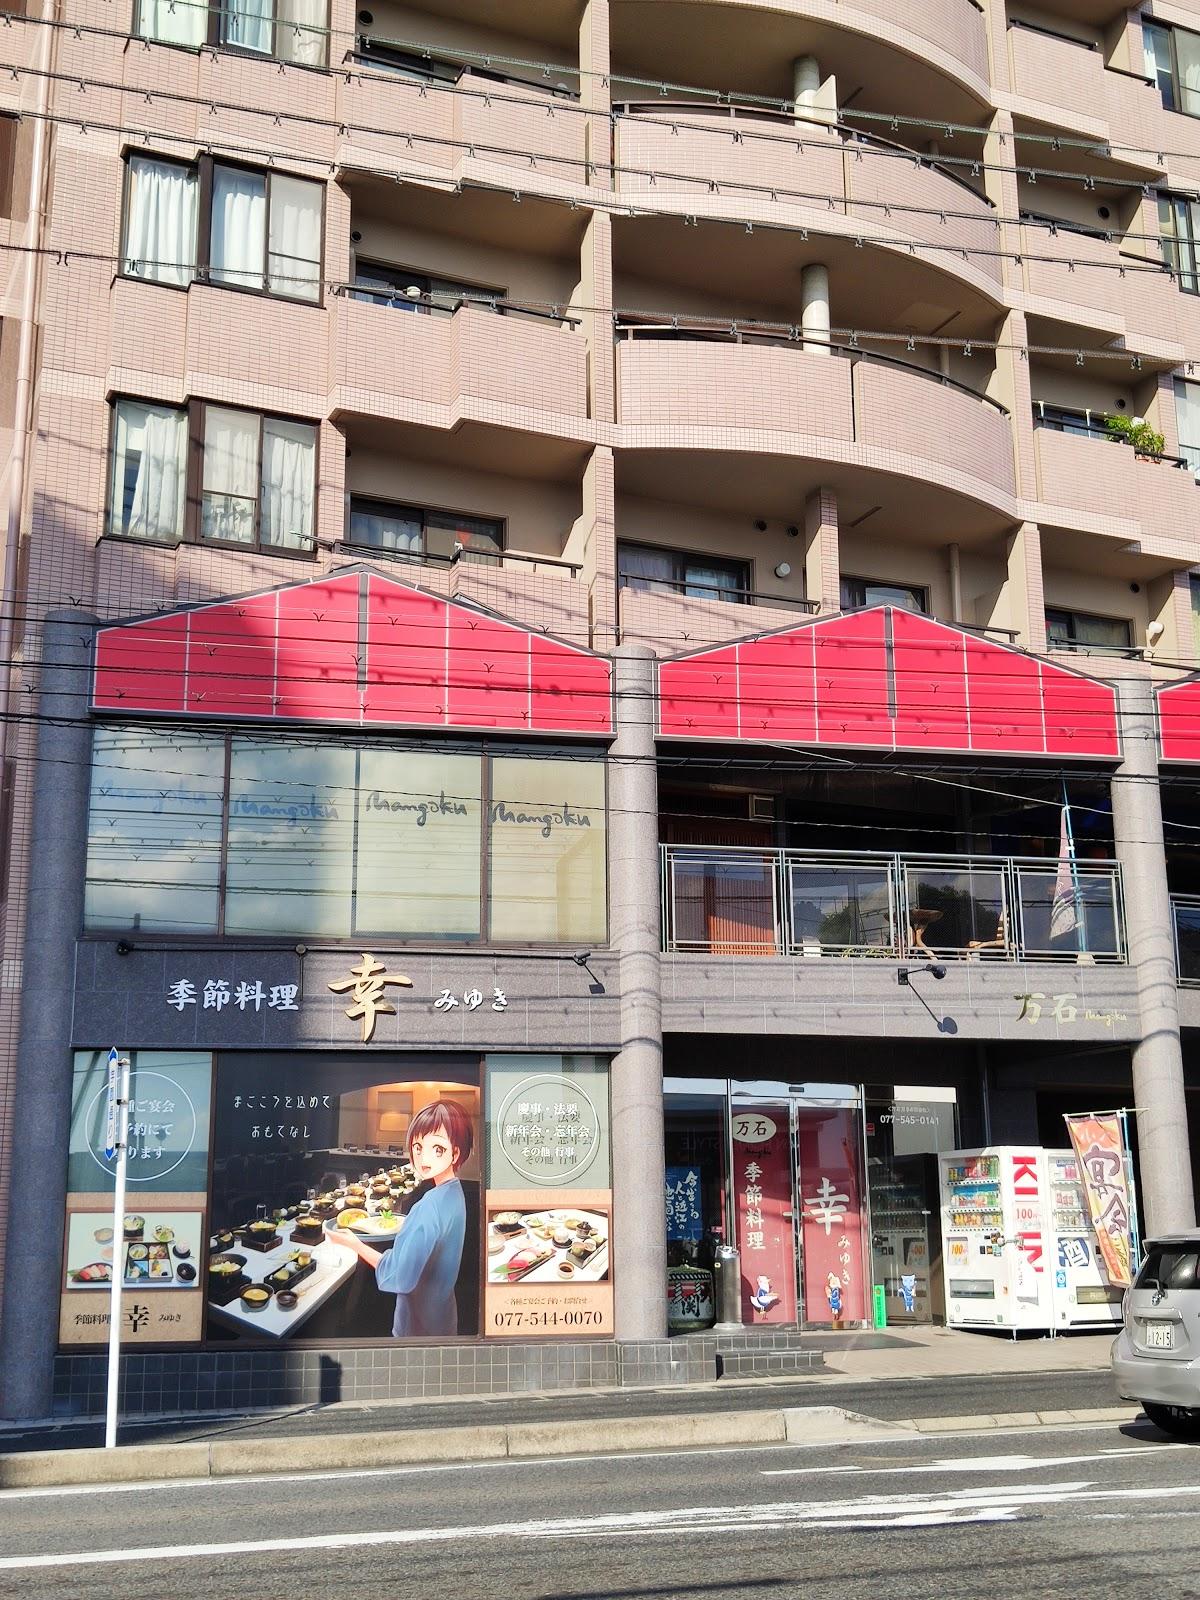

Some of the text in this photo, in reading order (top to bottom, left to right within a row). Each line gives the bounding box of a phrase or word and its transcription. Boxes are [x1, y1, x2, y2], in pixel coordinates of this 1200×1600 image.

[166, 952, 508, 1044] 季節料理 幸 みゆき
[1014, 992, 1077, 1025] 万石
[251, 1125, 311, 1138] おもてなし
[505, 1124, 591, 1138] 新年会・忘年会
[736, 1120, 767, 1136] 万石
[880, 1115, 939, 1125] 077-545-0141
[521, 1146, 576, 1158] その他 行事
[744, 1161, 766, 1250] 季節料理
[805, 1176, 850, 1236] 幸
[1012, 1156, 1044, 1272] KIIN
[838, 1235, 850, 1285] みゆき
[123, 1304, 150, 1333] 幸
[158, 1313, 182, 1323] みゆき
[494, 1311, 603, 1326] 077-544-0070
